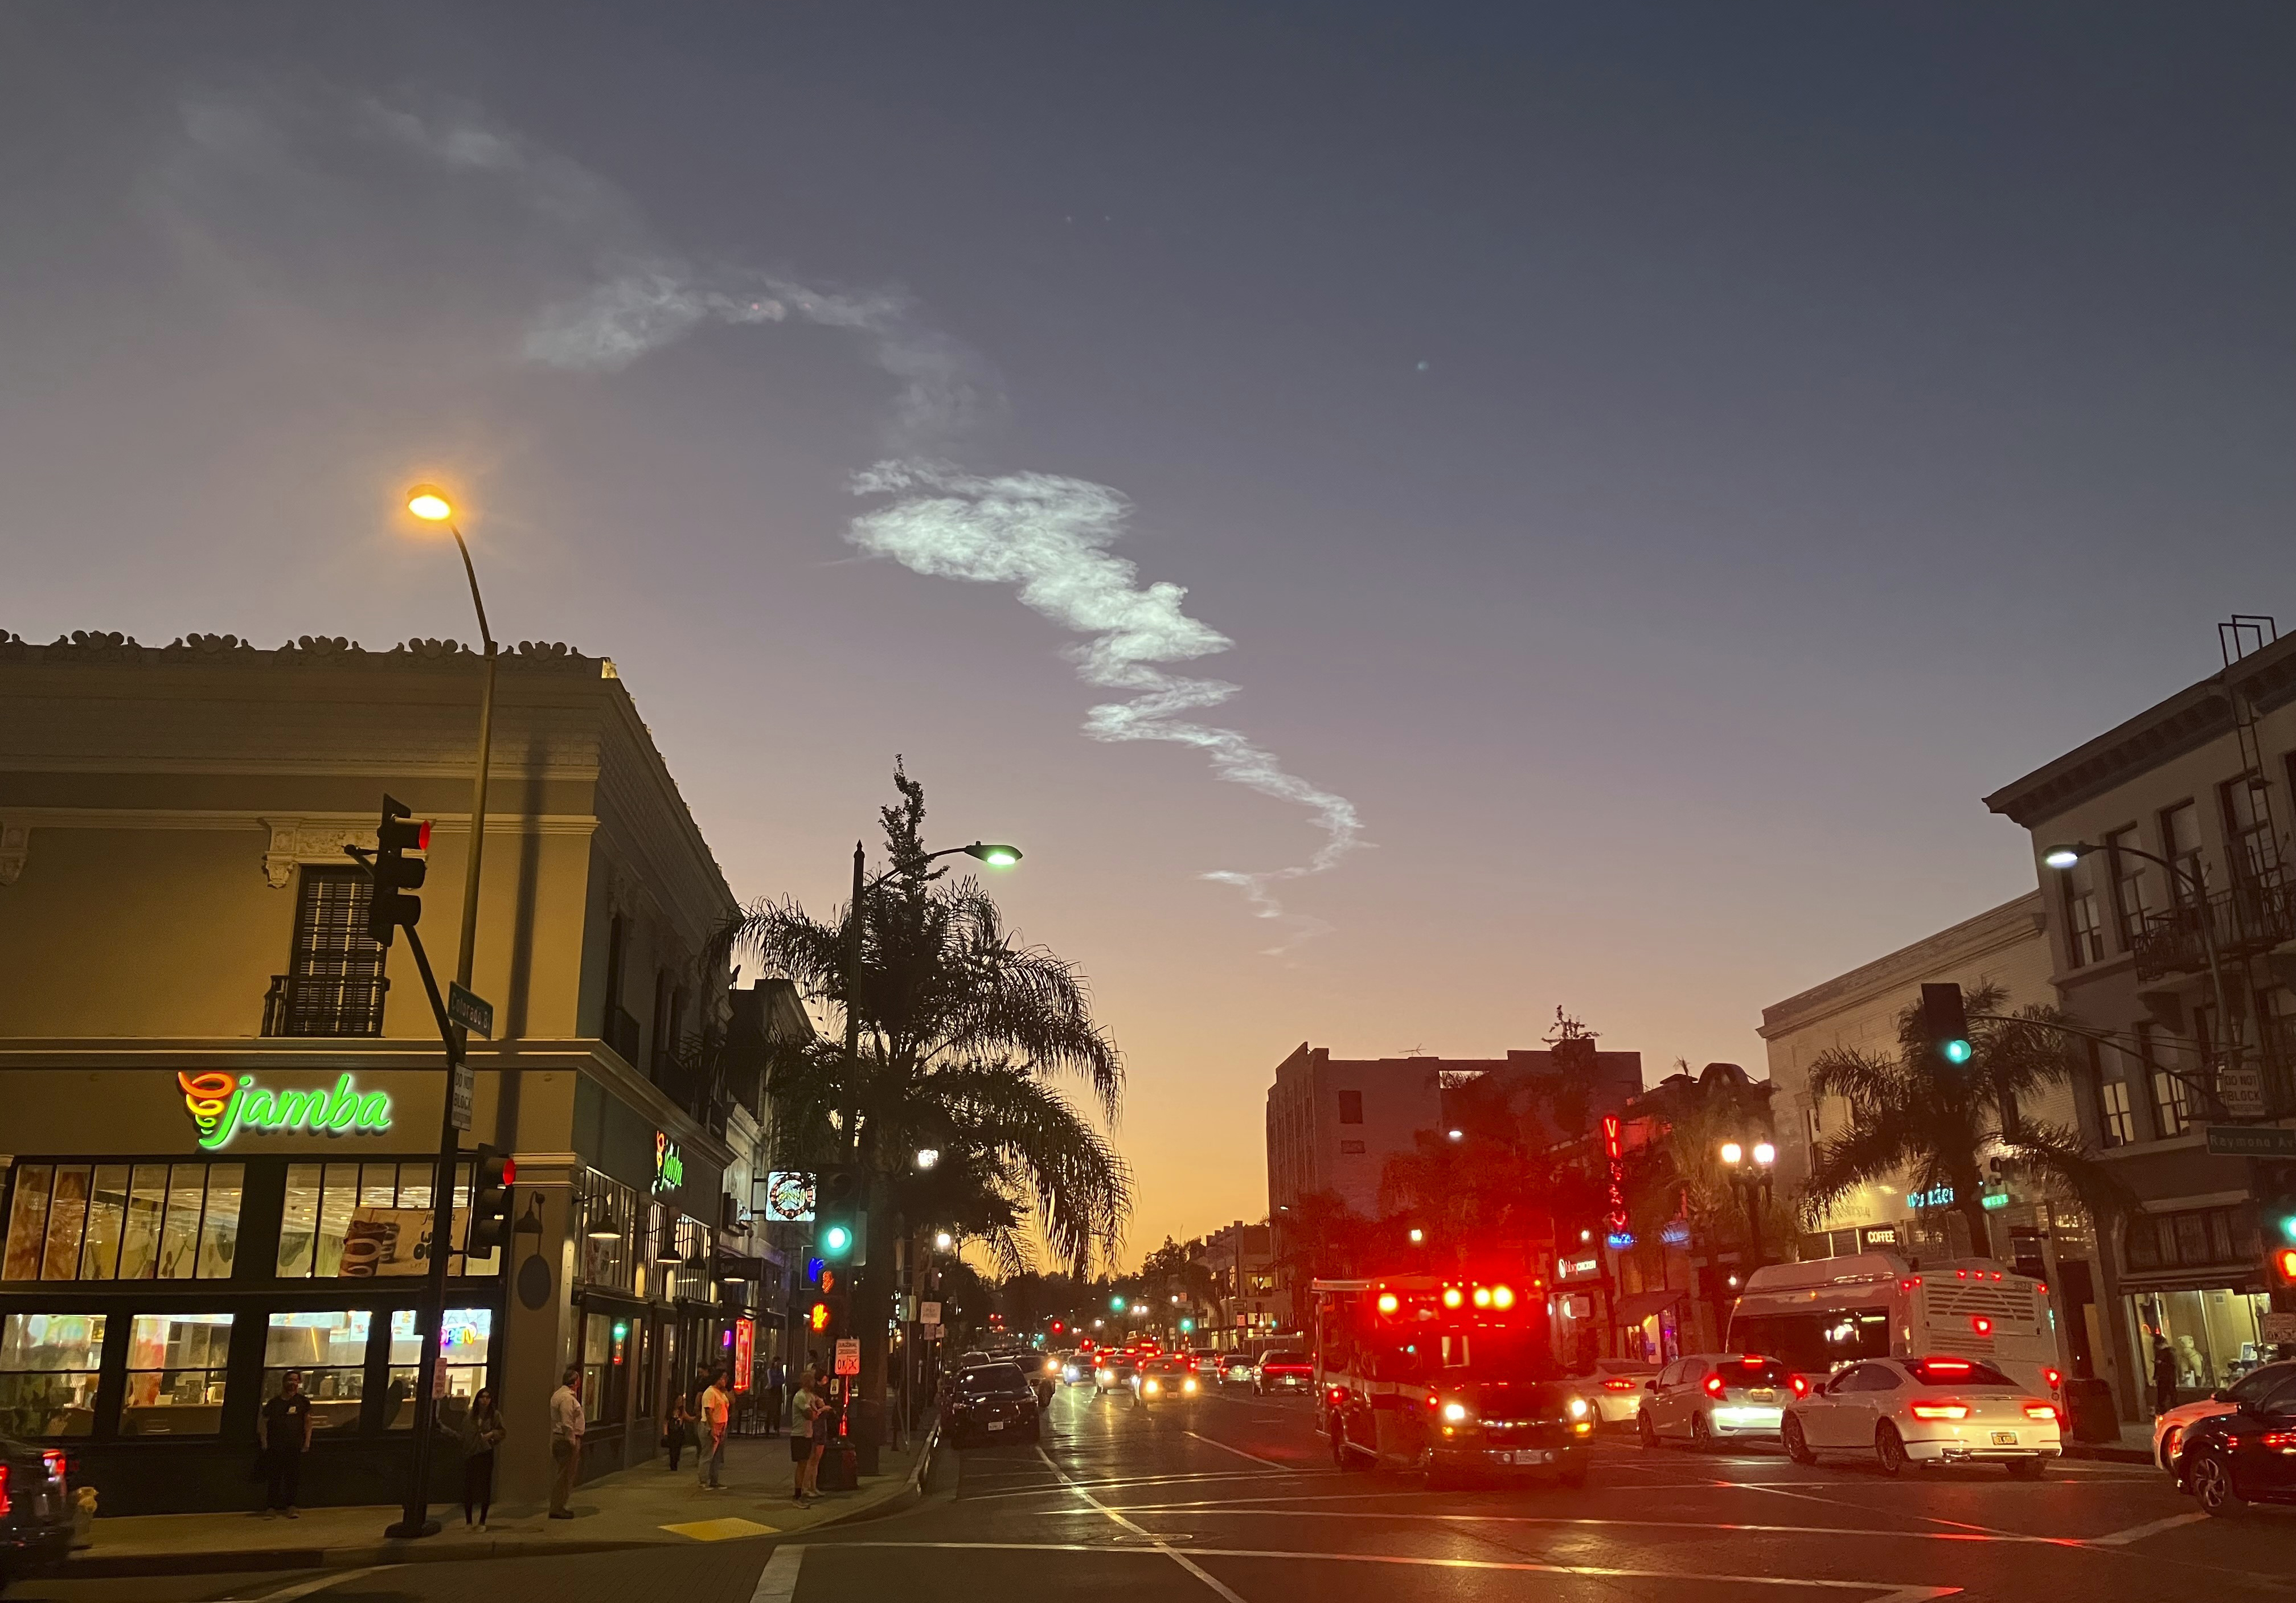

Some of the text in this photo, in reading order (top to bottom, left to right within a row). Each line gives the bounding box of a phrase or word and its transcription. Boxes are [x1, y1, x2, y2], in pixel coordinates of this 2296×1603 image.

[452, 991, 481, 1025] Colorado
[456, 1072, 463, 1088] DO
[2225, 1076, 2256, 1086] DO NOT
[454, 1092, 471, 1110] BLOCK
[2229, 1090, 2261, 1101] BLOCK
[199, 1073, 390, 1147] jamba
[2210, 1134, 2270, 1148] Raymond
[1867, 1231, 1896, 1243] COFFEE
